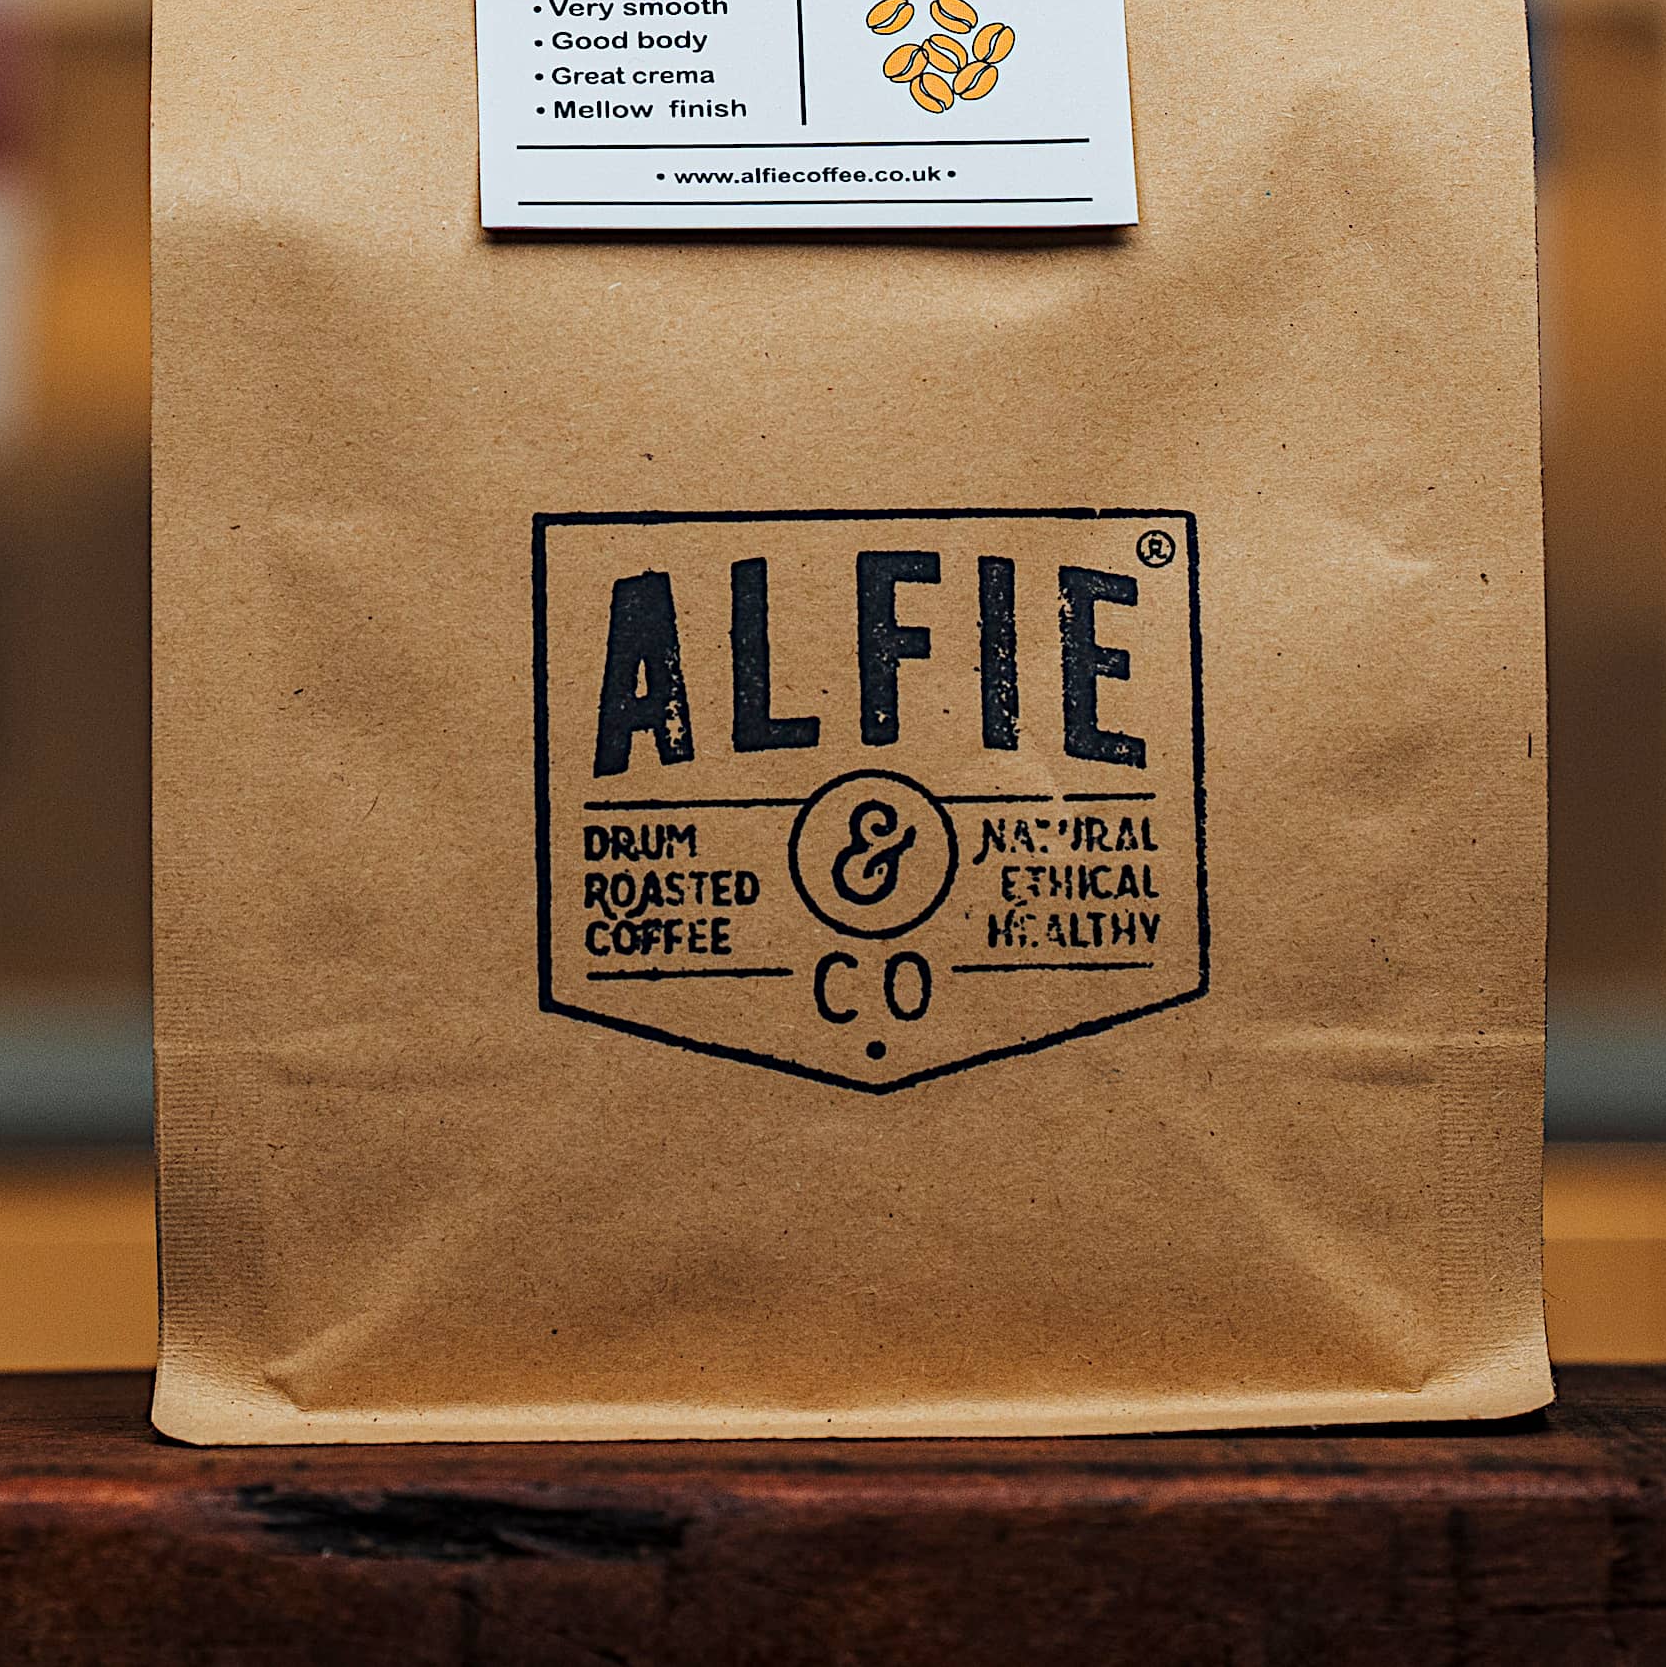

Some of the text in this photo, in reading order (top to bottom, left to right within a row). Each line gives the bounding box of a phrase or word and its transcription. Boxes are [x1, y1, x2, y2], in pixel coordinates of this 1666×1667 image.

[551, 30, 708, 54] Good body
[551, 66, 715, 85] Great crema
[554, 98, 747, 119] Mellow finish
[674, 165, 942, 184] www.alfiecoffee.co.uk
[593, 549, 1147, 779] ALFIE
[583, 824, 697, 861] DRUM
[584, 870, 760, 919] ROASTED
[1002, 864, 1159, 901] ETHICAL
[585, 917, 732, 956] COFFEE
[814, 951, 932, 1024] CO
